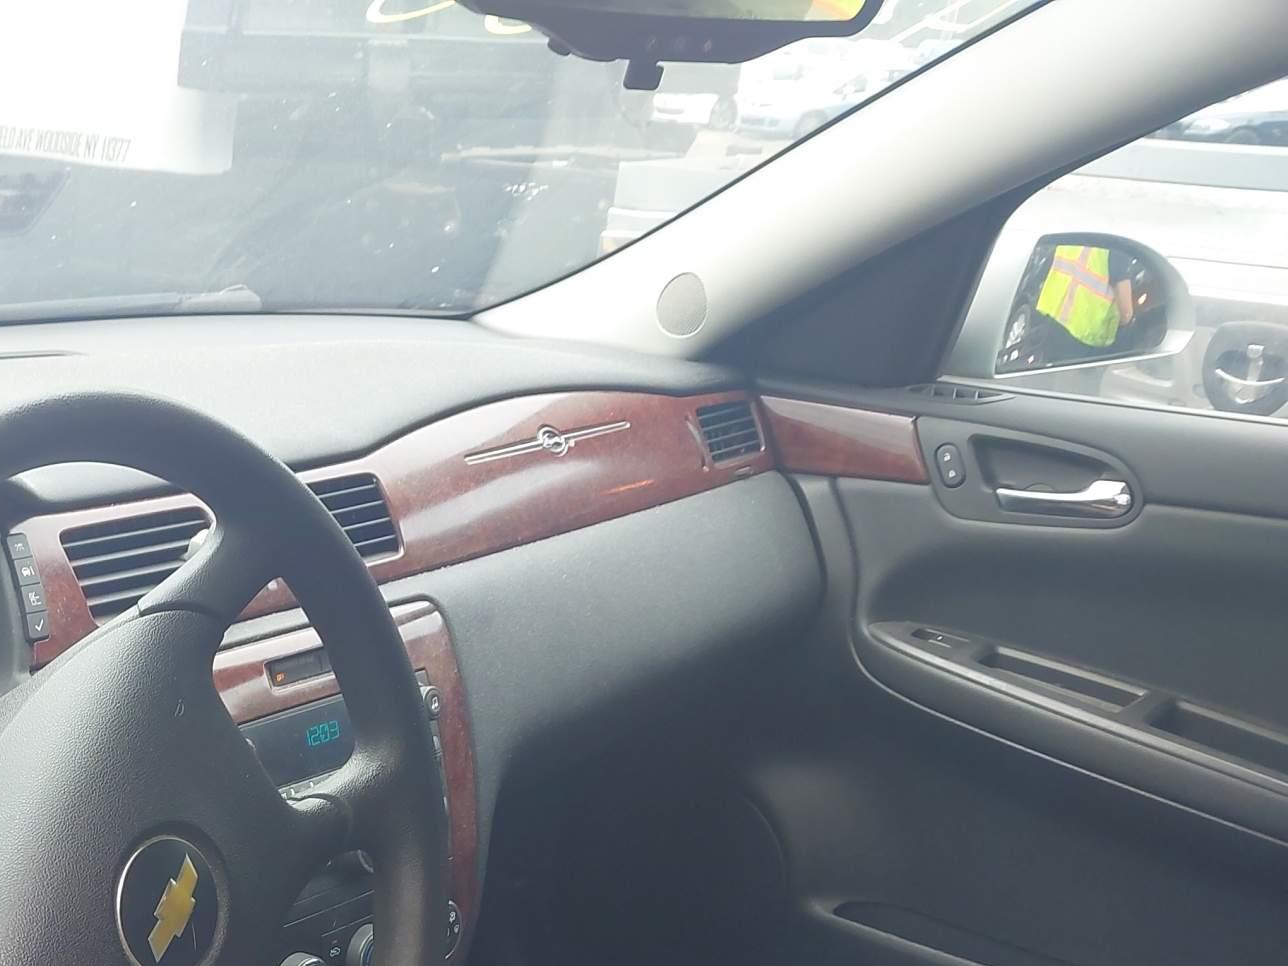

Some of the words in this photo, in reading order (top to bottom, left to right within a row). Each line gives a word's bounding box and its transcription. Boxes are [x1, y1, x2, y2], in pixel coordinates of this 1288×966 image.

[15, 128, 35, 152] AVE
[34, 129, 83, 159] WOODSIDE
[83, 134, 100, 161] NY
